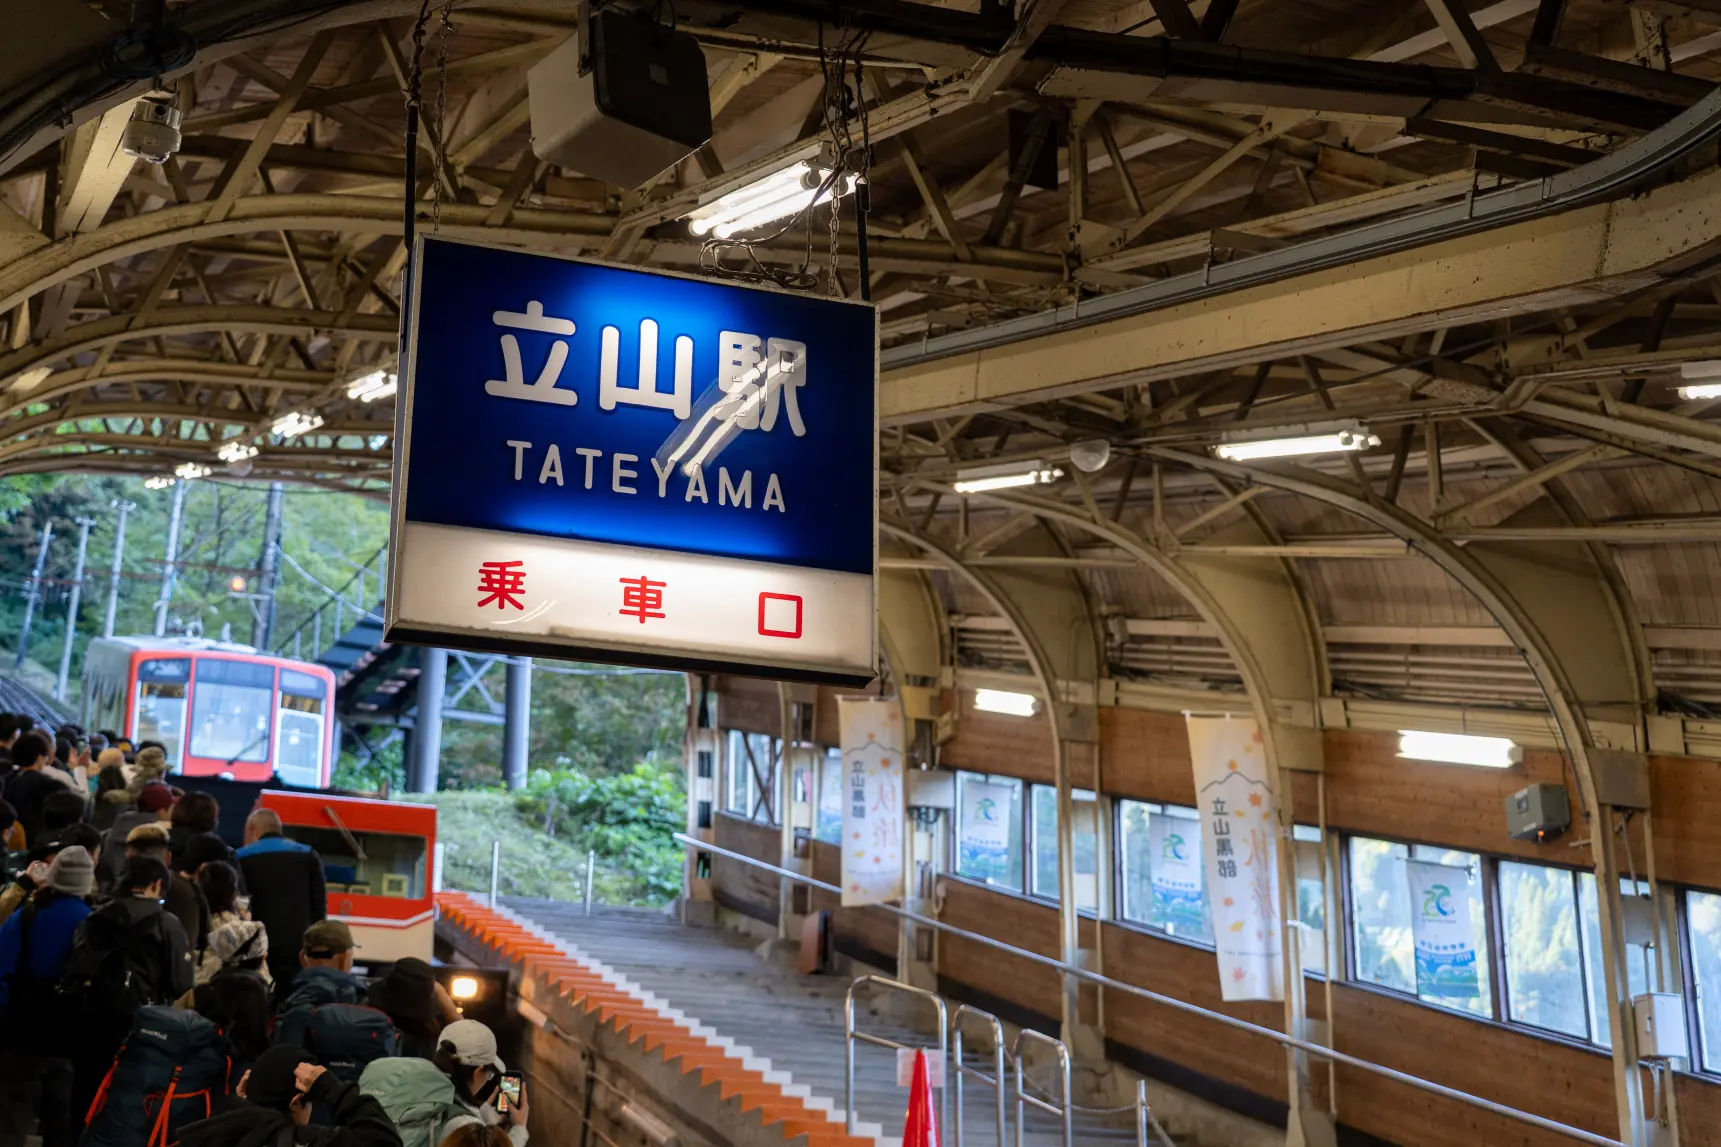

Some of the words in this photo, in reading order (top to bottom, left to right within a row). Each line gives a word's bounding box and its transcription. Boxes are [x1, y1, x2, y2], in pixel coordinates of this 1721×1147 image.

[485, 300, 807, 437] 立山駅
[506, 440, 787, 513] TATEYAMA
